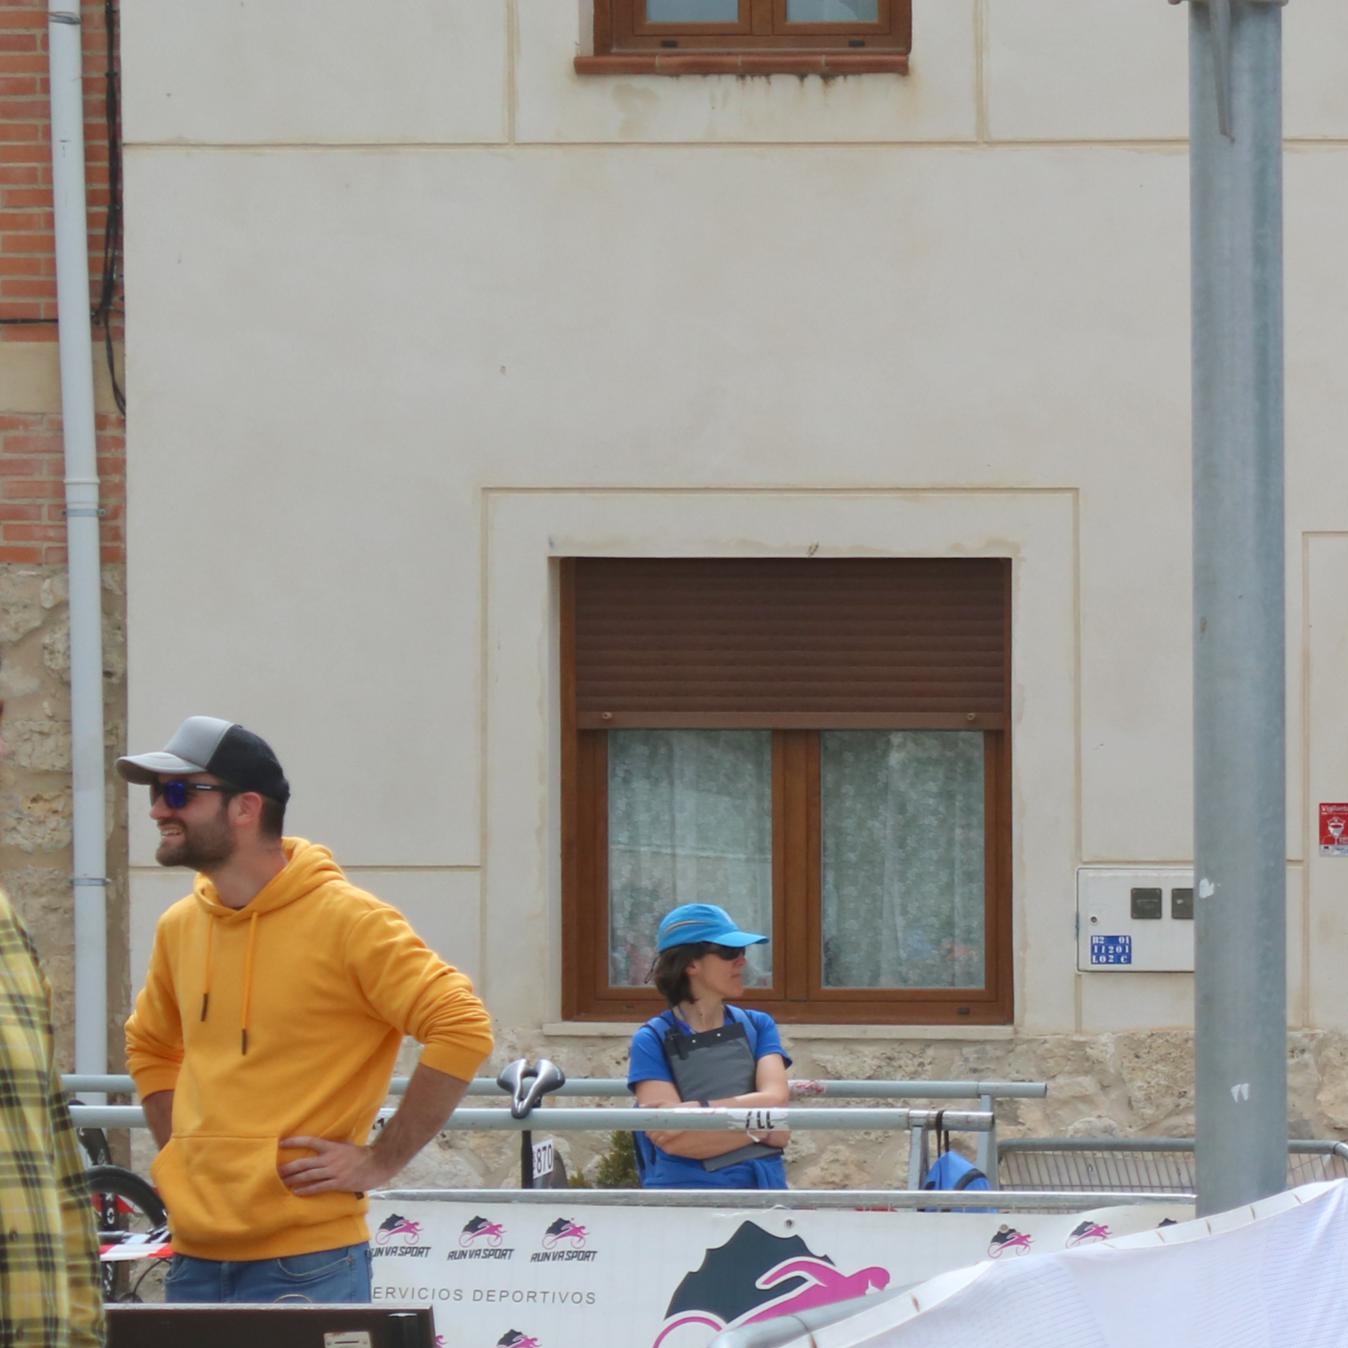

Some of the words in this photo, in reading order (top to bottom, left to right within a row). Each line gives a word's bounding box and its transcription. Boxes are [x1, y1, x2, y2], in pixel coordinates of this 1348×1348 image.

[397, 1246, 432, 1257] SPORT
[481, 1248, 515, 1260] SPORT
[564, 1250, 598, 1262] SPORT
[373, 1286, 463, 1301] ERVICIOS
[473, 1289, 596, 1304] DEPORTIVOS
